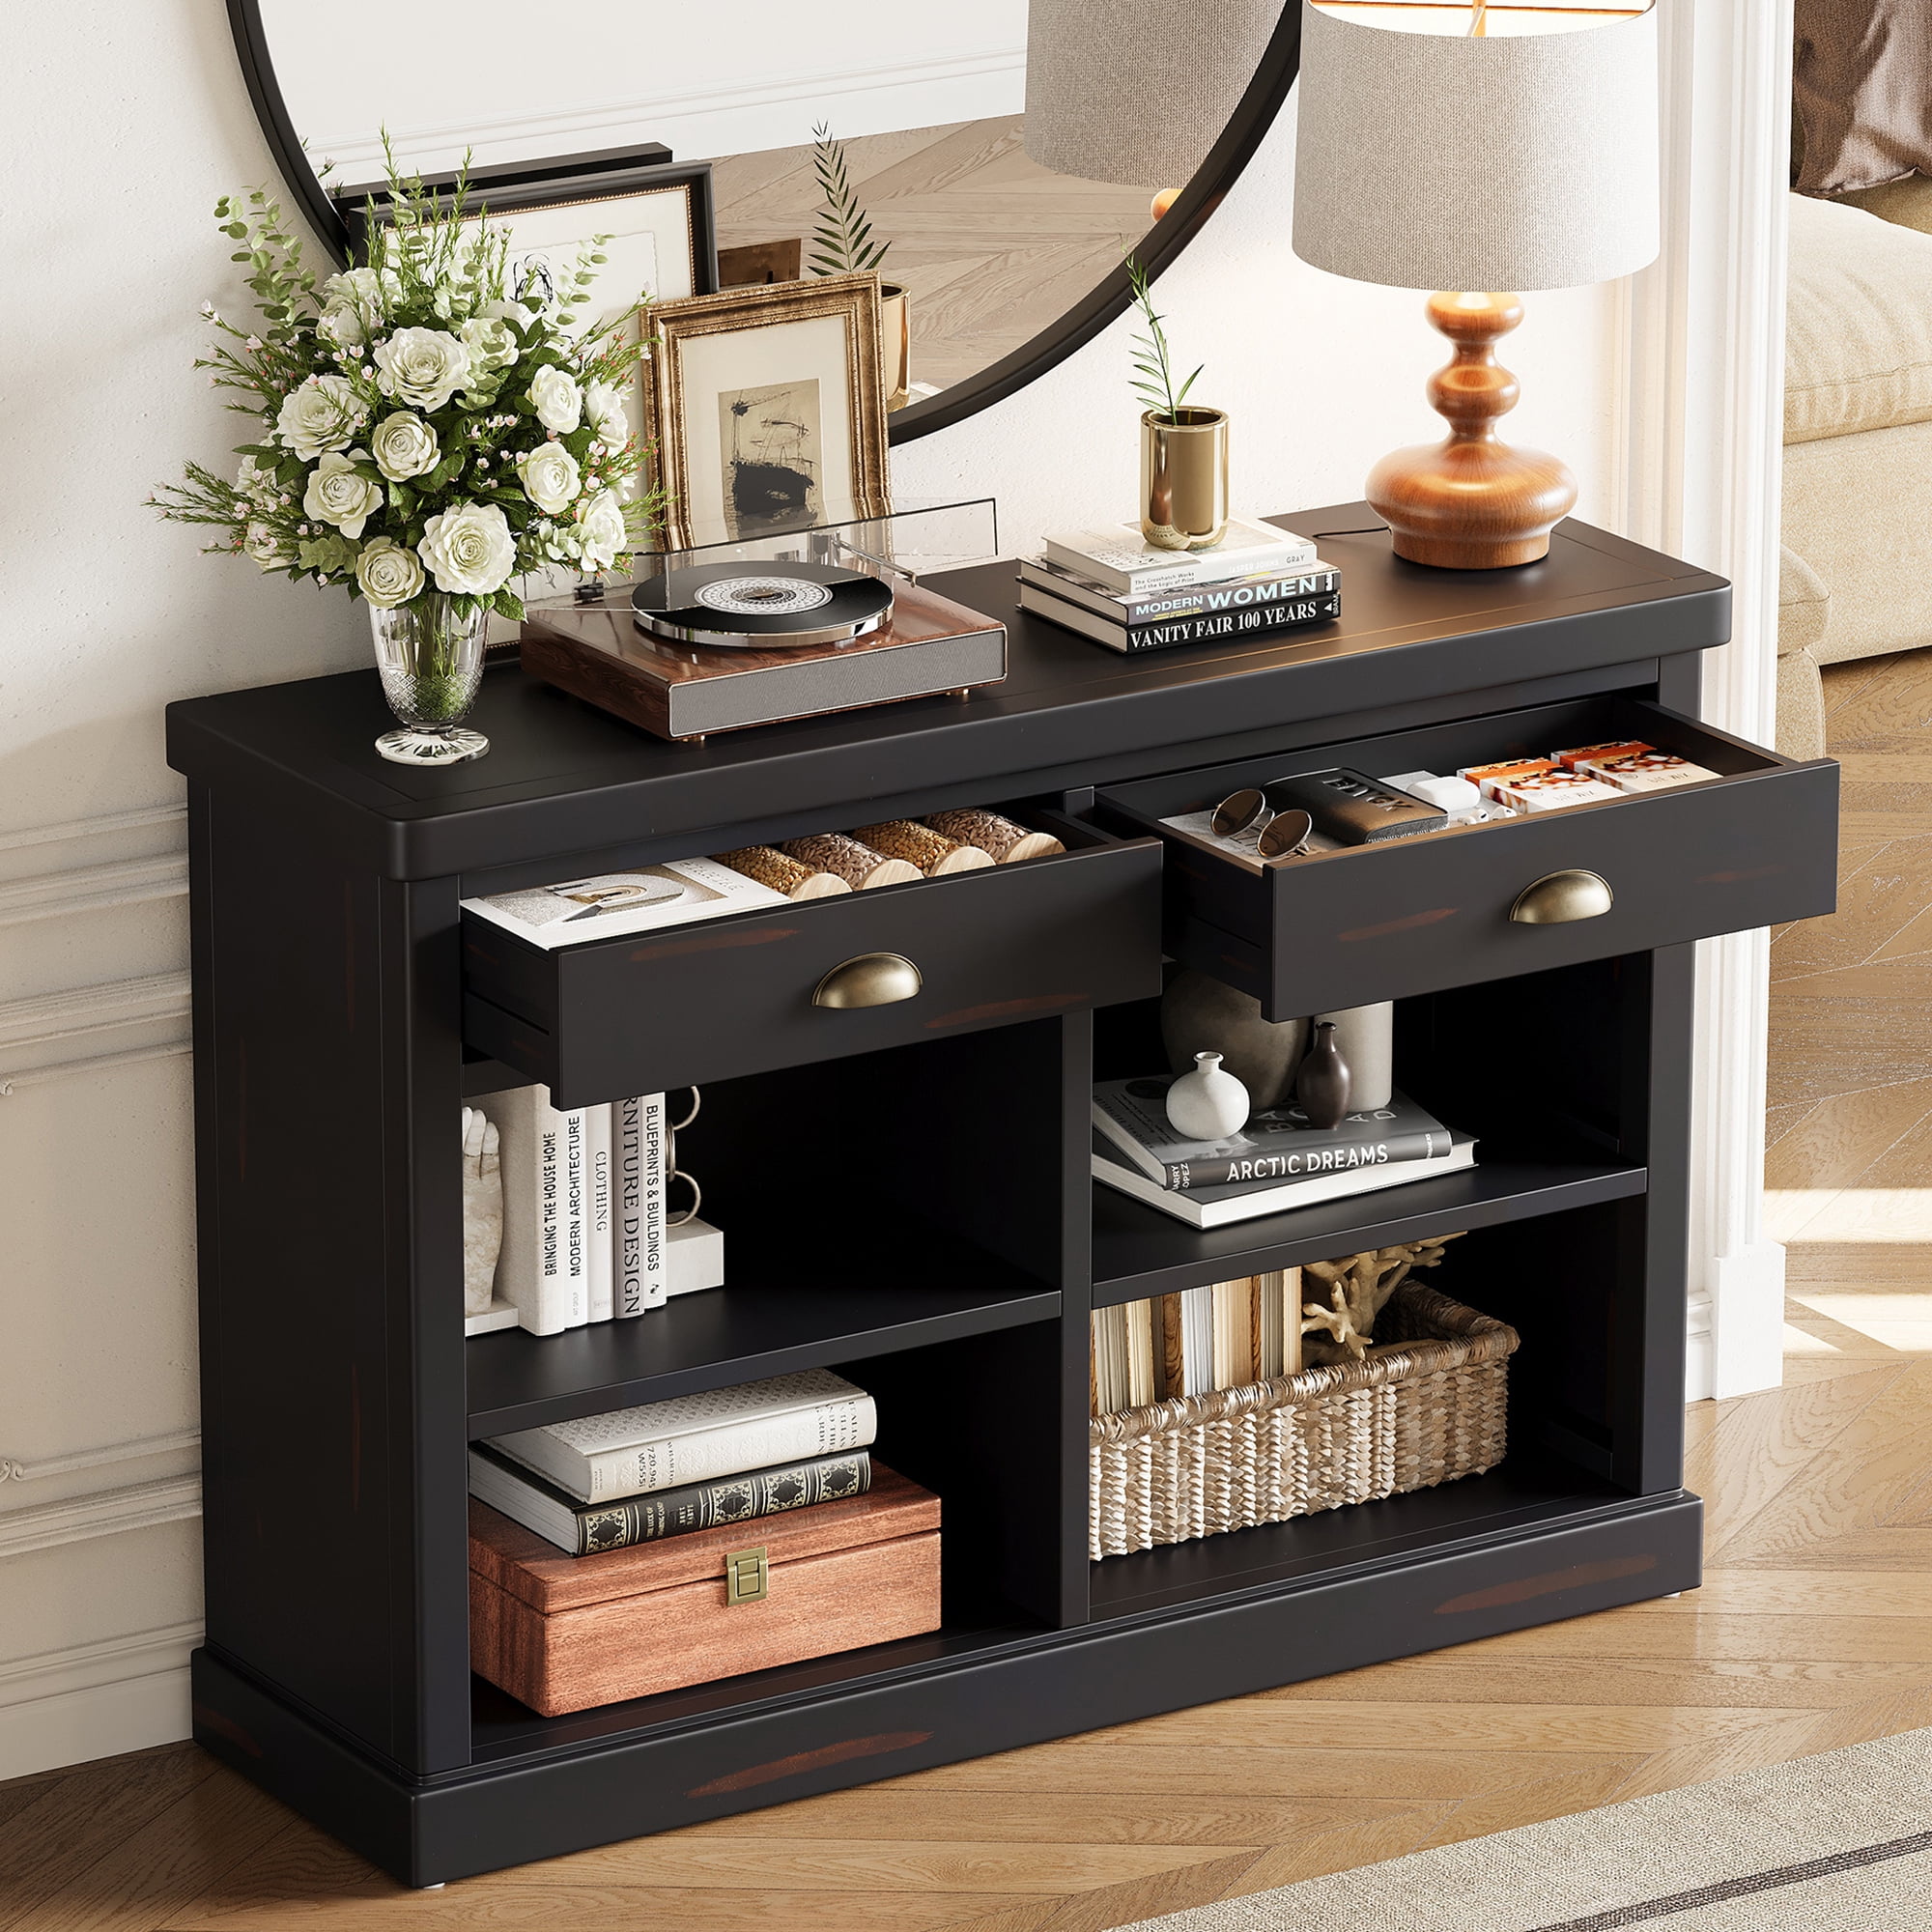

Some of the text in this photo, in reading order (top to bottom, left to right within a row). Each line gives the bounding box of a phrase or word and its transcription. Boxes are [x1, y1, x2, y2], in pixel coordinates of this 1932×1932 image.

[1286, 554, 1305, 564] GRAY
[1135, 595, 1204, 616] MODERN
[1208, 578, 1317, 610] WOMEN
[1130, 602, 1317, 649] VANITY FAIR 100 YEARS
[568, 1116, 581, 1216] ARCHITECTURE
[645, 1104, 661, 1272] BLUEPRINTS & BUILDINGS
[1171, 1165, 1180, 1190] ARRY
[1180, 1162, 1190, 1189] OPEZ
[1226, 1144, 1389, 1181] ARCTIC DREAMS
[543, 1131, 557, 1277] BRINGING THE HOUSE HOME
[595, 1151, 608, 1232] CLOTHING
[622, 1097, 641, 1315] RNITURE DESIGN
[569, 1220, 582, 1277] MODERN
